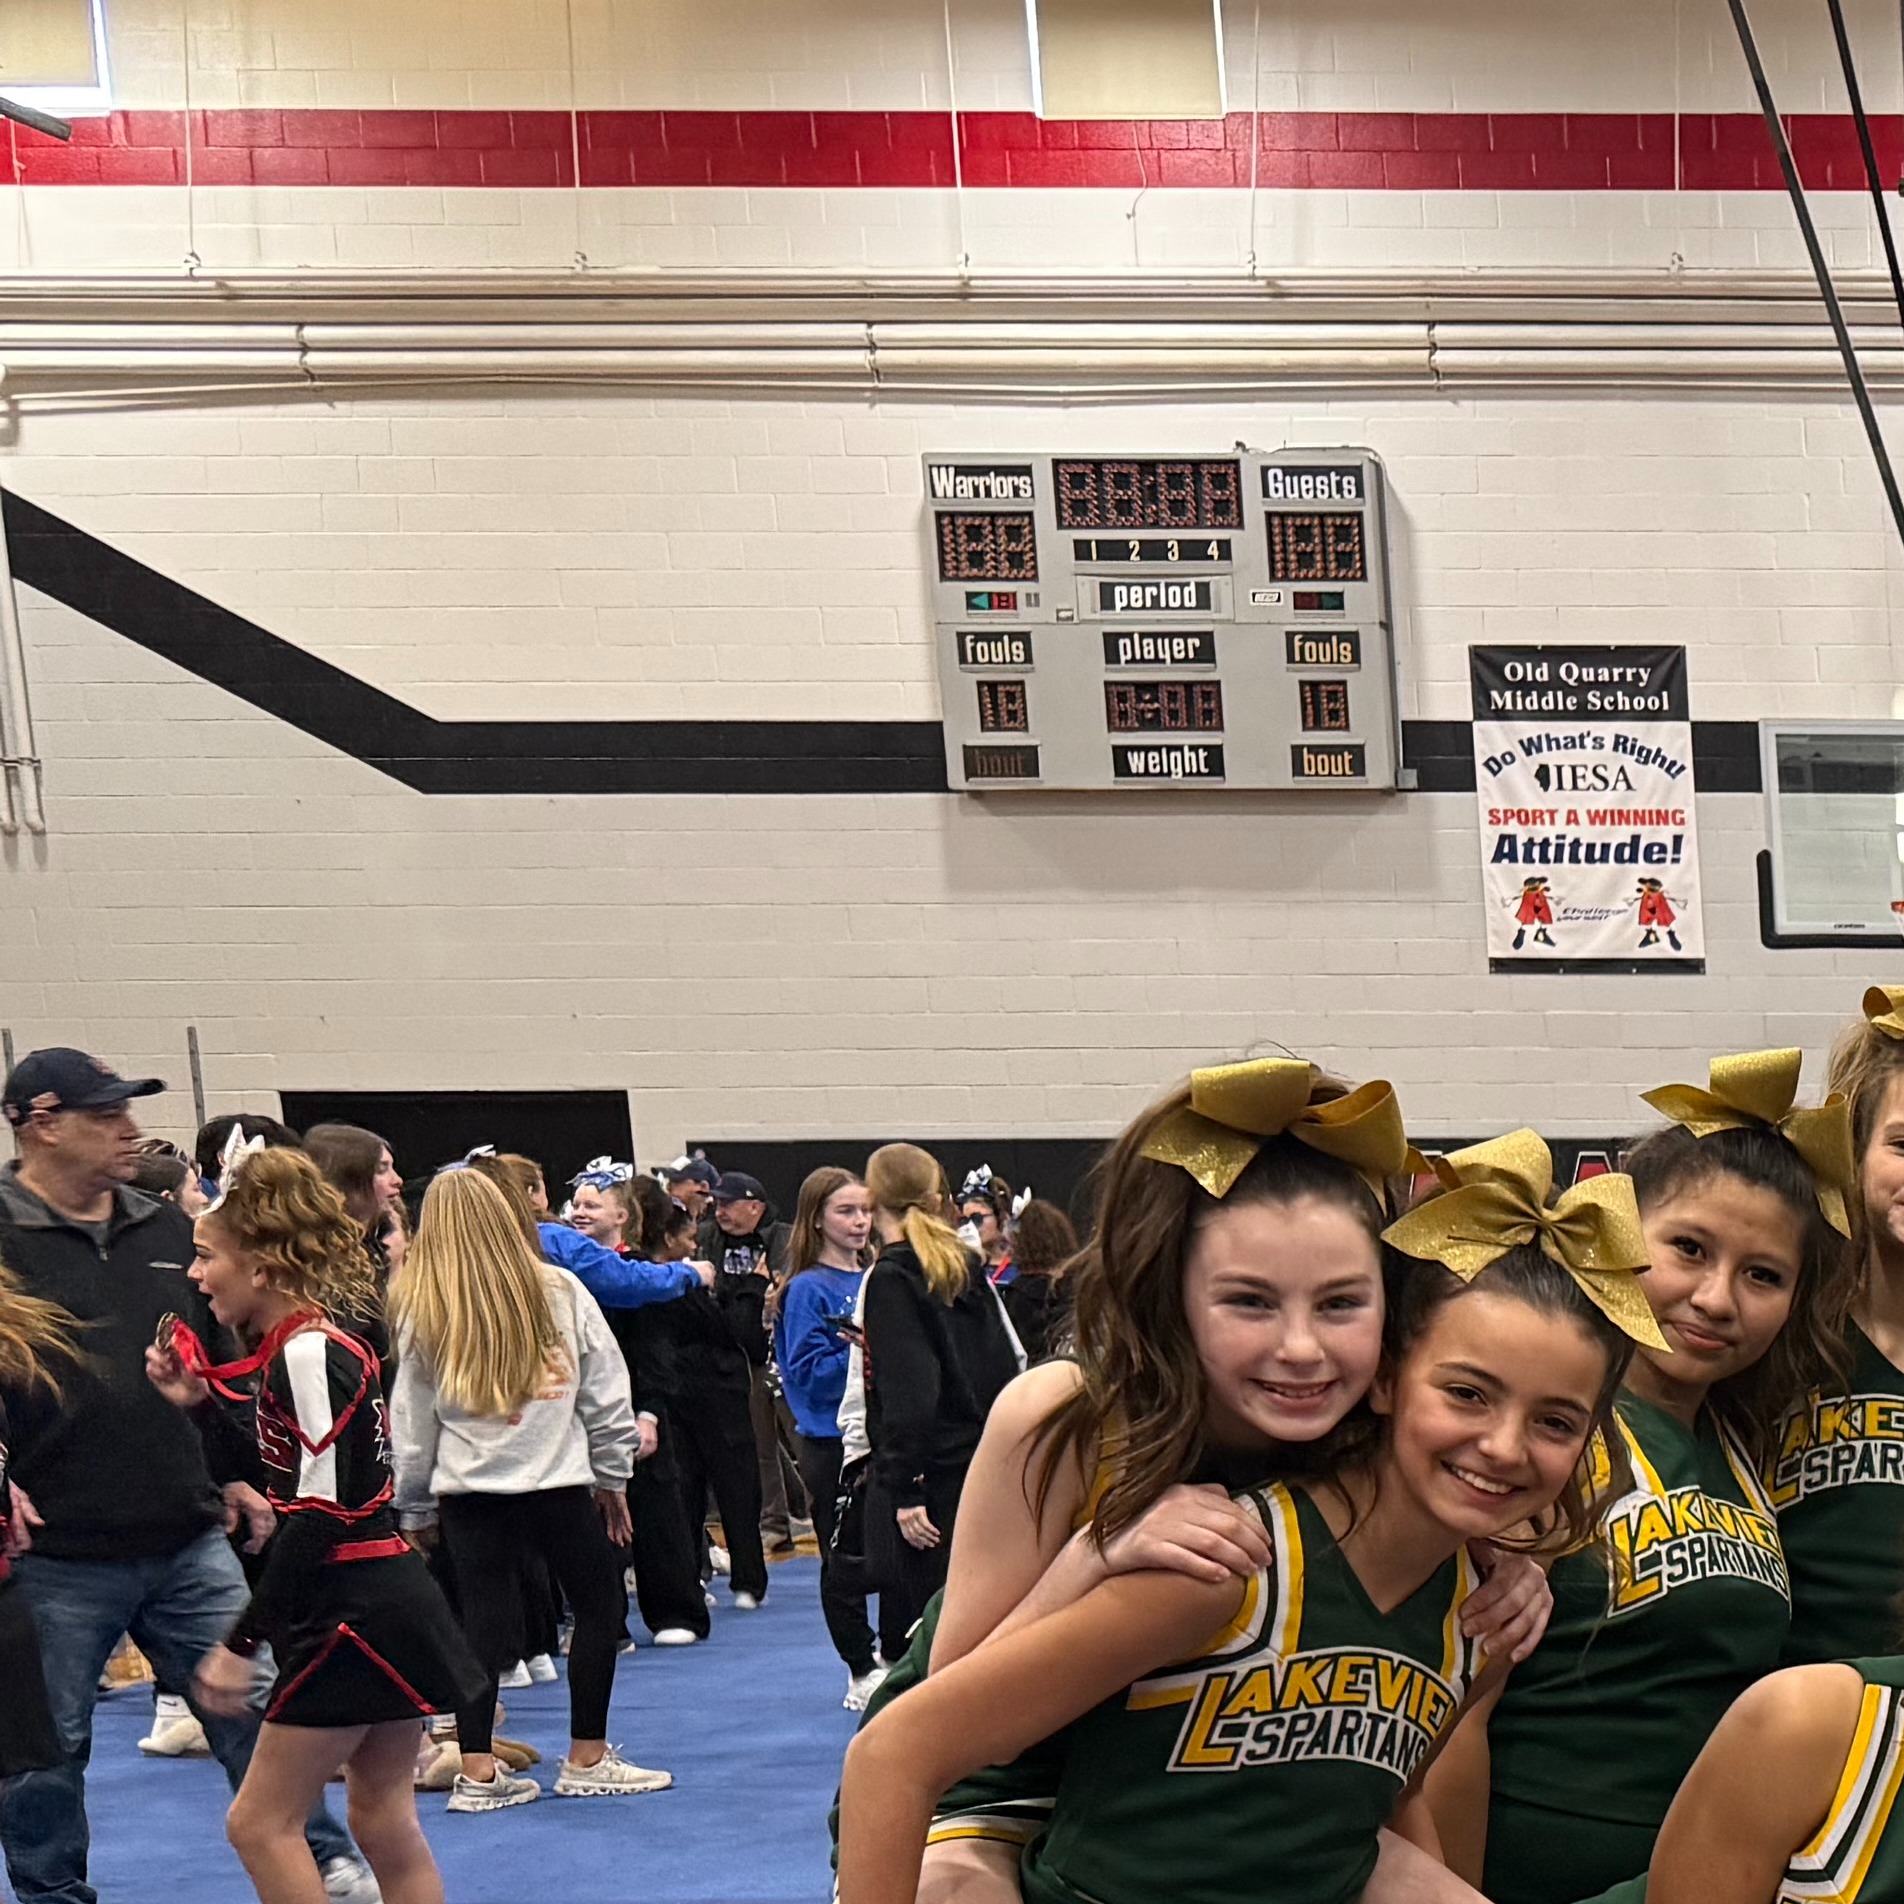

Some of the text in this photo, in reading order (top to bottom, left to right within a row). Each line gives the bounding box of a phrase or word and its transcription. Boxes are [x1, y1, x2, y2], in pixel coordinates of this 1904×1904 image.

[932, 466, 1033, 499] Warriors
[1267, 467, 1357, 500] Guests
[1090, 541, 1220, 561] 1 2 3 4
[1114, 581, 1197, 613] period
[964, 634, 1026, 664] fouls
[1118, 634, 1201, 666] player
[1293, 634, 1353, 665] fouls
[1504, 661, 1653, 687] Old Quarry
[1490, 690, 1670, 712] Middle School
[1127, 746, 1210, 779] weight
[1302, 748, 1354, 777] bout
[1482, 750, 1517, 778] Do
[1518, 730, 1606, 759] What's
[1554, 763, 1637, 792] IESA
[1488, 807, 1687, 827] SPORT A WINNING
[1490, 833, 1685, 865] Attitude!
[1167, 1646, 1462, 1772] LAKEVIE
